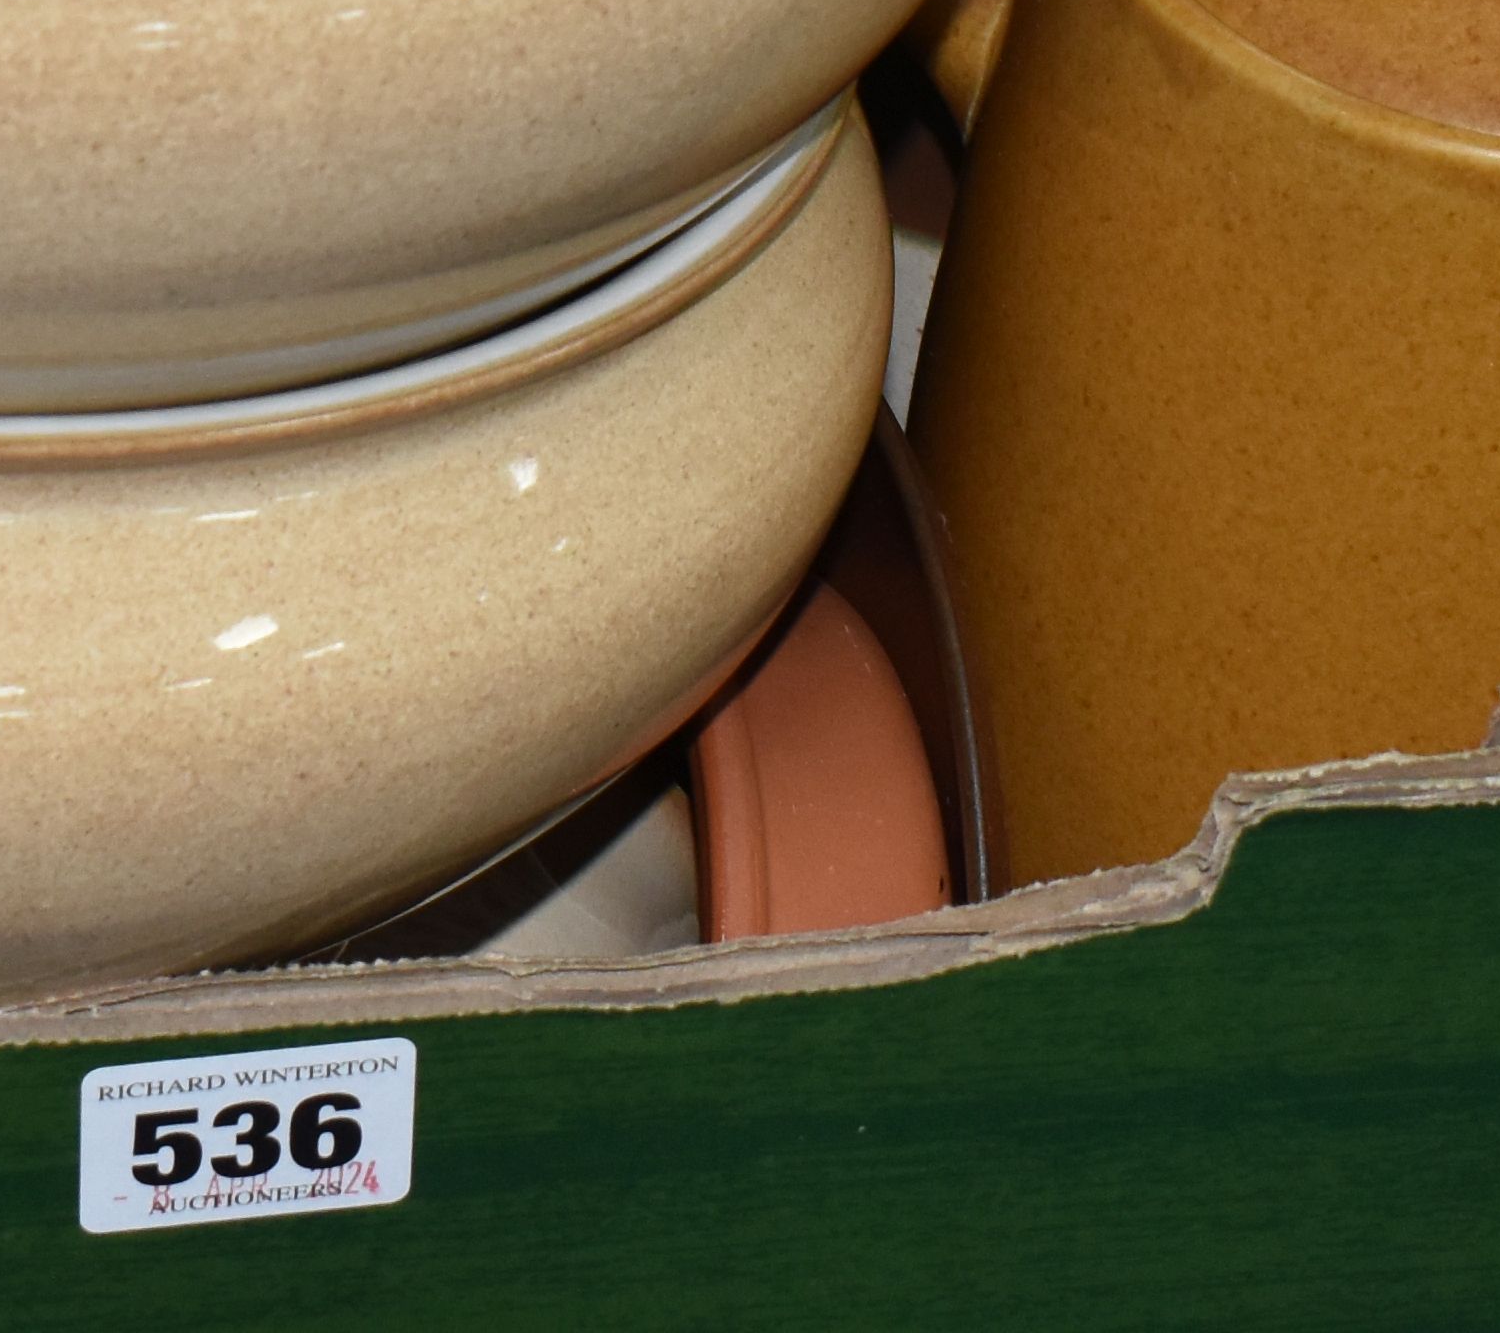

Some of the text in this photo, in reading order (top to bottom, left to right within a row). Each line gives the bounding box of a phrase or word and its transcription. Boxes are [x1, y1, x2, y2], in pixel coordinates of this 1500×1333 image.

[98, 1055, 400, 1101] RICHARD WINTERTON
[131, 1091, 363, 1186] 536
[149, 1180, 343, 1215] AUCTIONEERS
[309, 1160, 381, 1201] 2024
